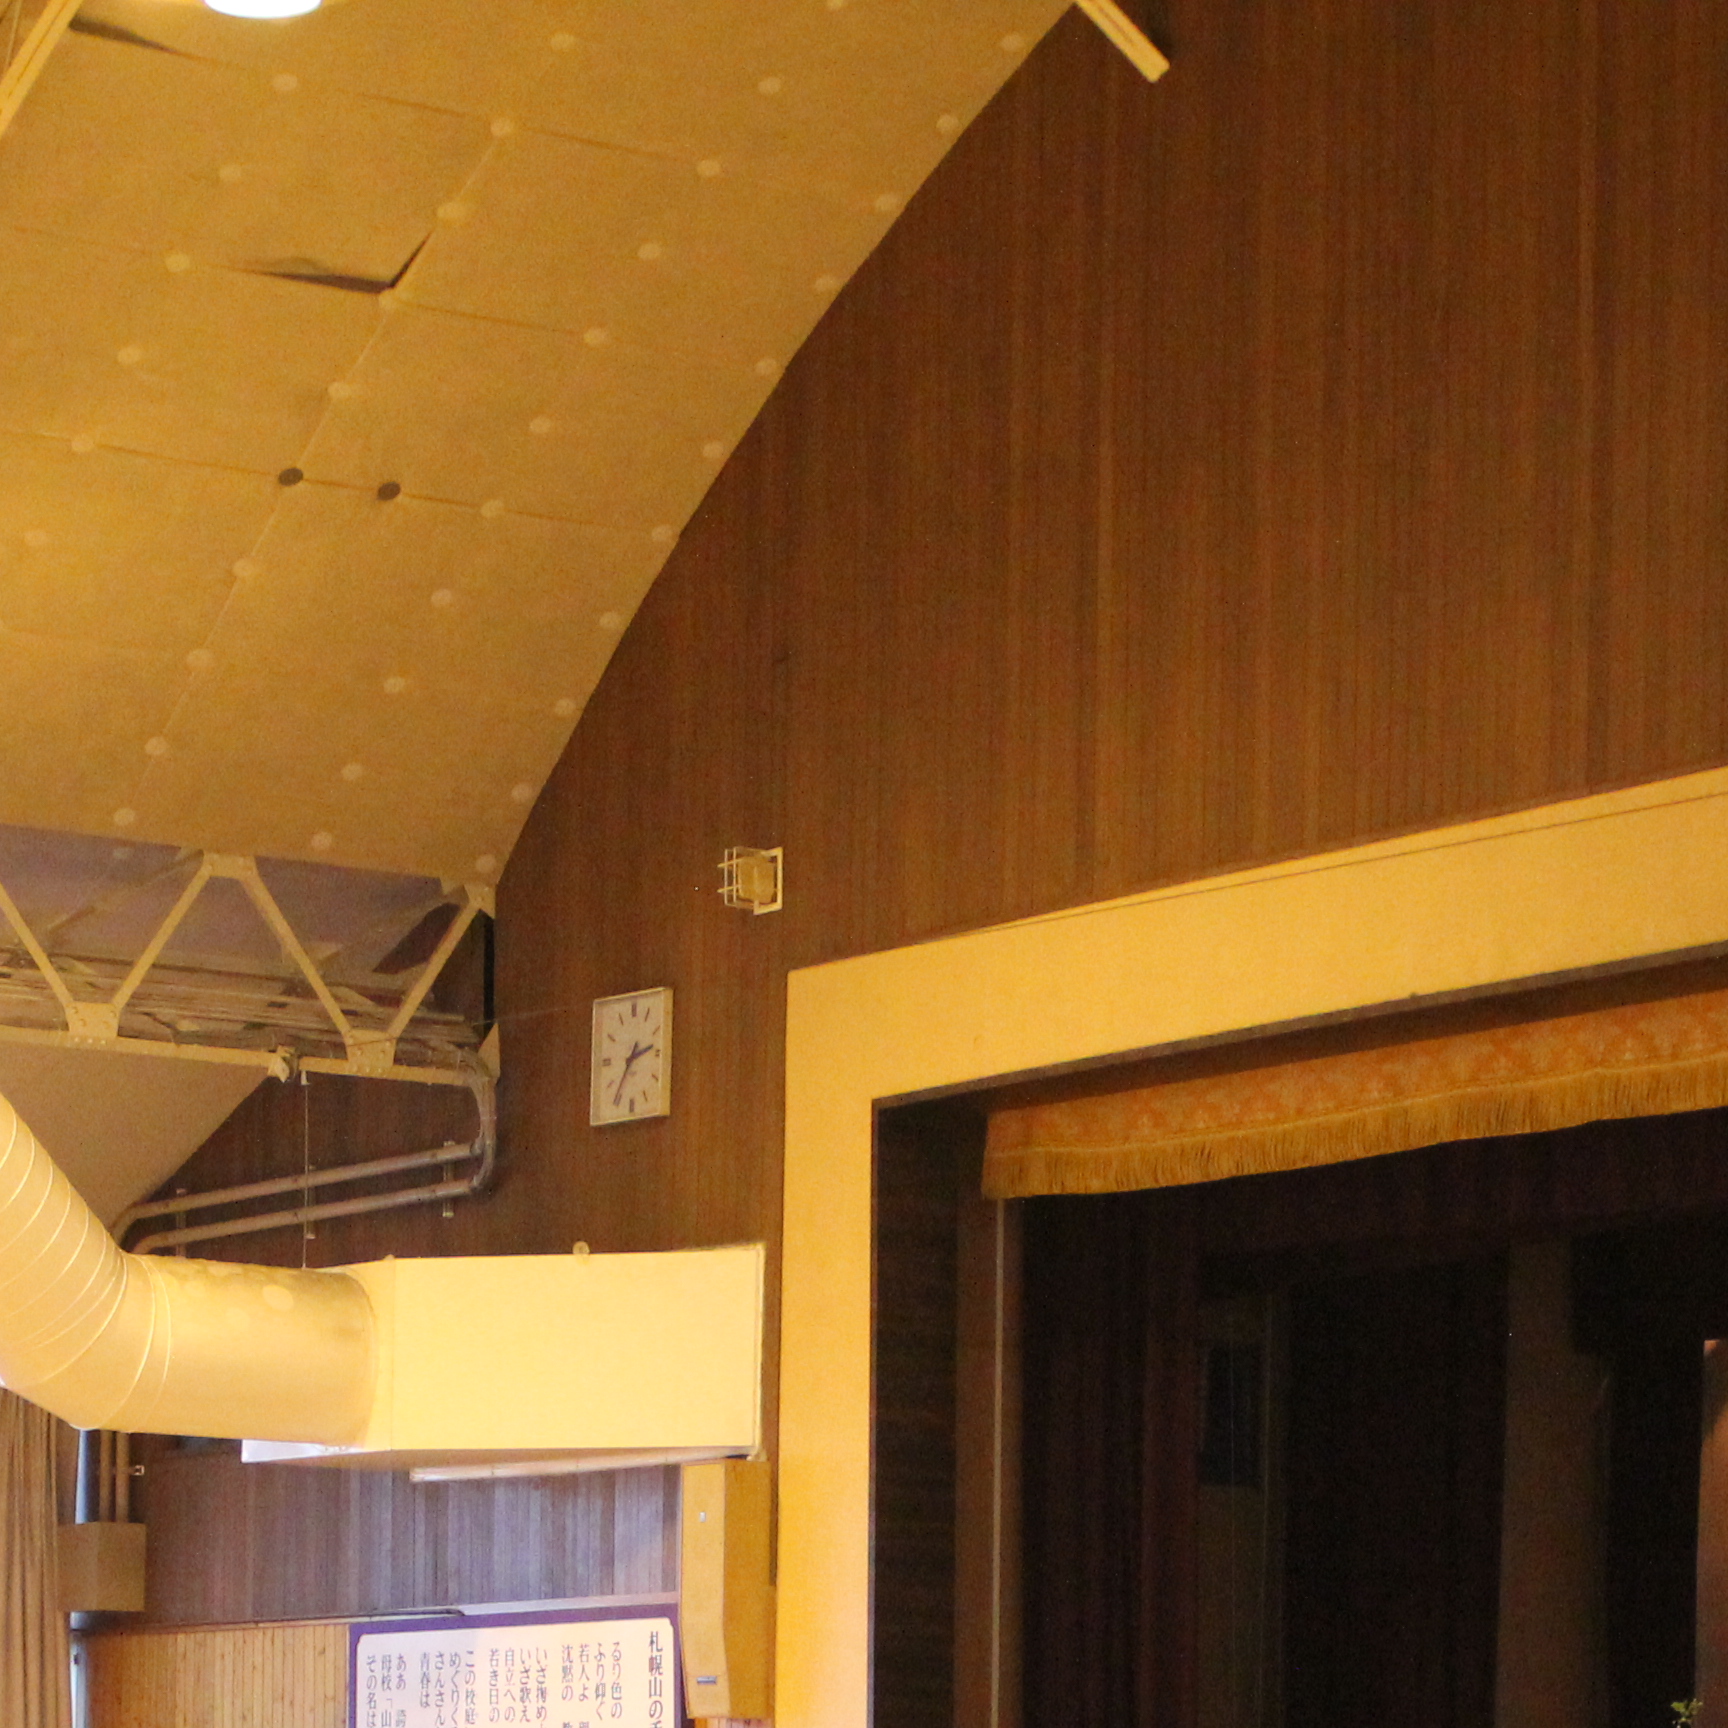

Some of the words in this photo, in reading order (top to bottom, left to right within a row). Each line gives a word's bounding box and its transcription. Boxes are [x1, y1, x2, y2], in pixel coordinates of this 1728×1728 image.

[395, 1653, 407, 1691] ああ
[488, 1648, 500, 1723] 若き日の
[503, 1647, 516, 1722] 自立への
[561, 1644, 574, 1702] 沈黙の
[578, 1643, 590, 1702] 若人よ
[611, 1641, 622, 1719] るり色の
